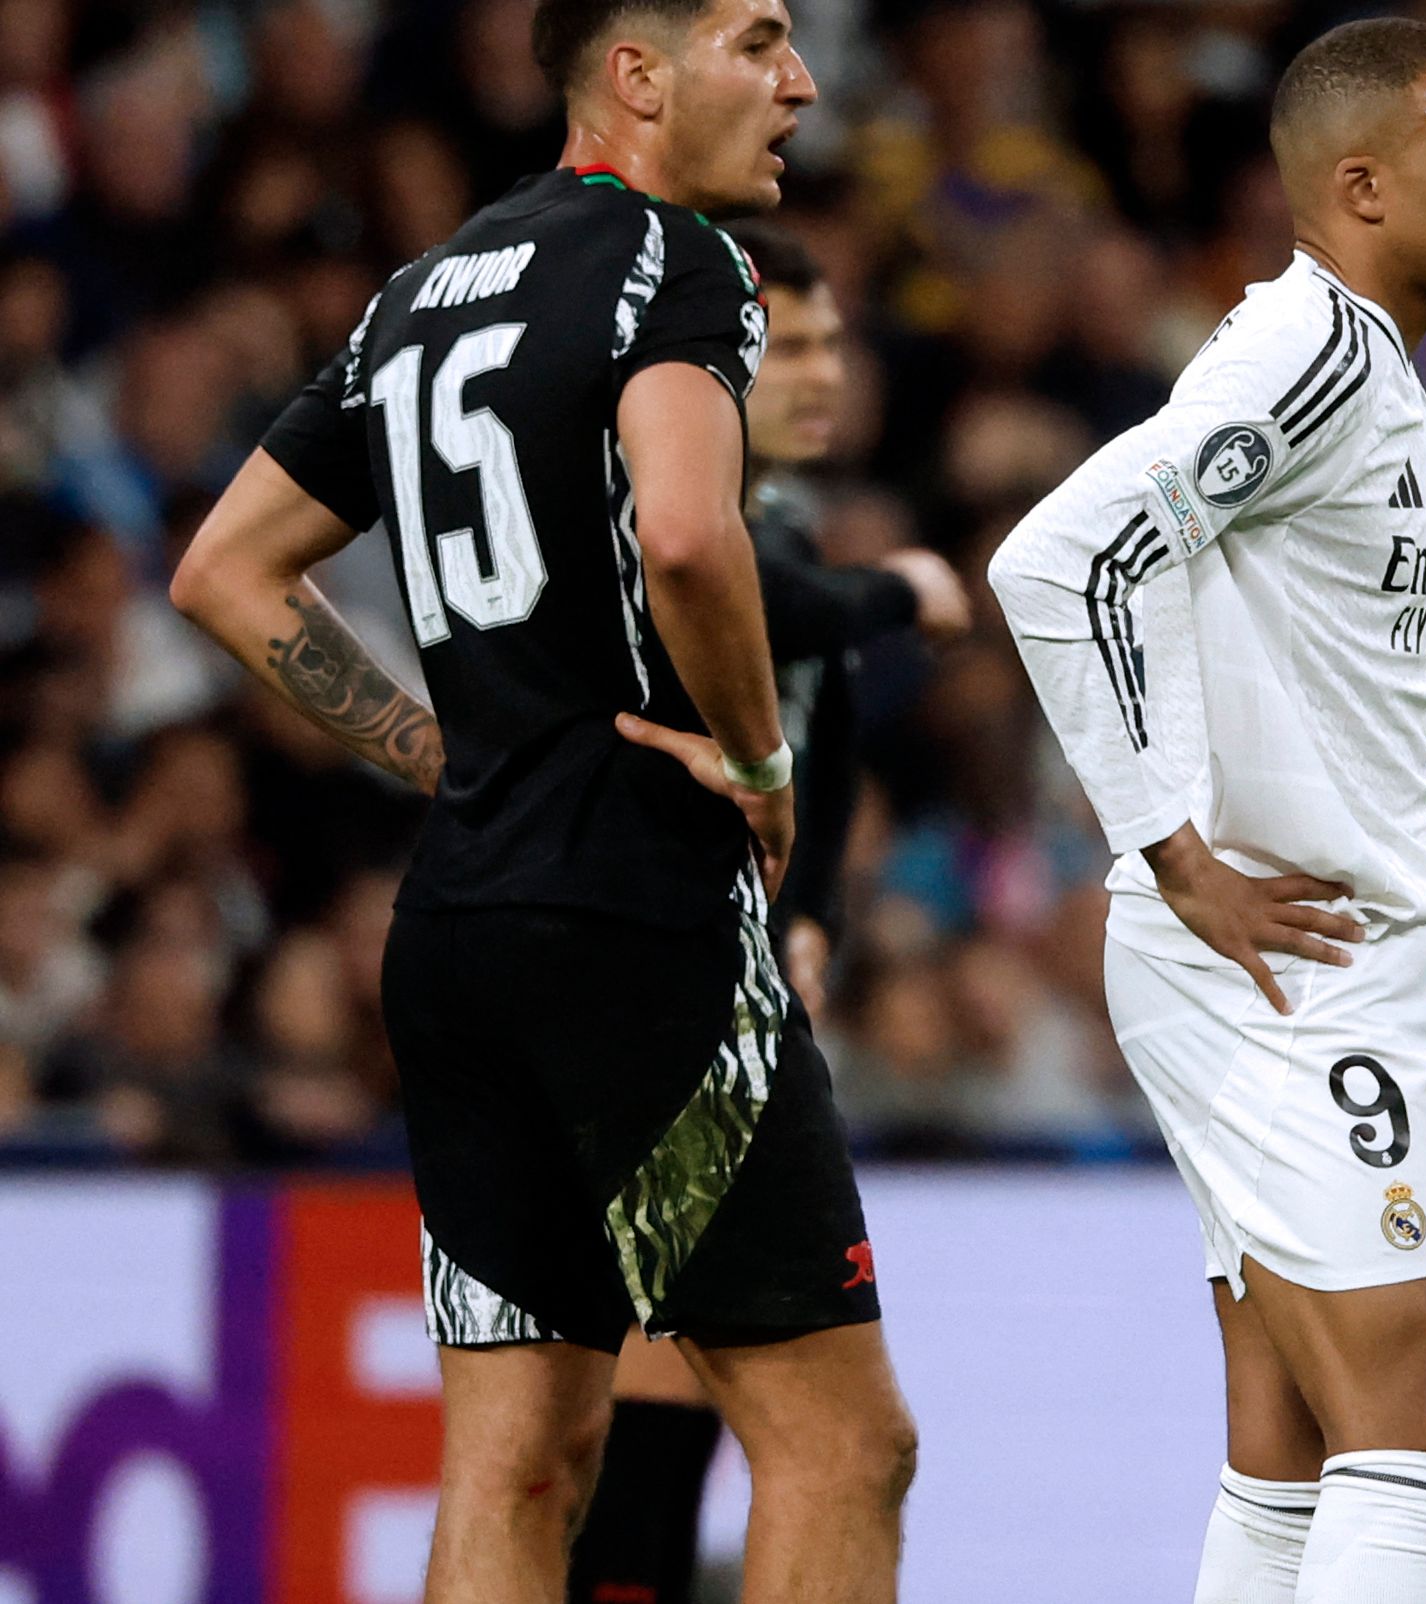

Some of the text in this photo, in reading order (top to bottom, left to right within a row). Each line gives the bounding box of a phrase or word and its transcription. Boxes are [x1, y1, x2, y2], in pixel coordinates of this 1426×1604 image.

[410, 240, 536, 313] KIWIOR
[371, 322, 549, 648] 15
[1149, 463, 1206, 548] FOUNDATION
[1217, 457, 1240, 482] 15
[1329, 1054, 1411, 1169] 9
